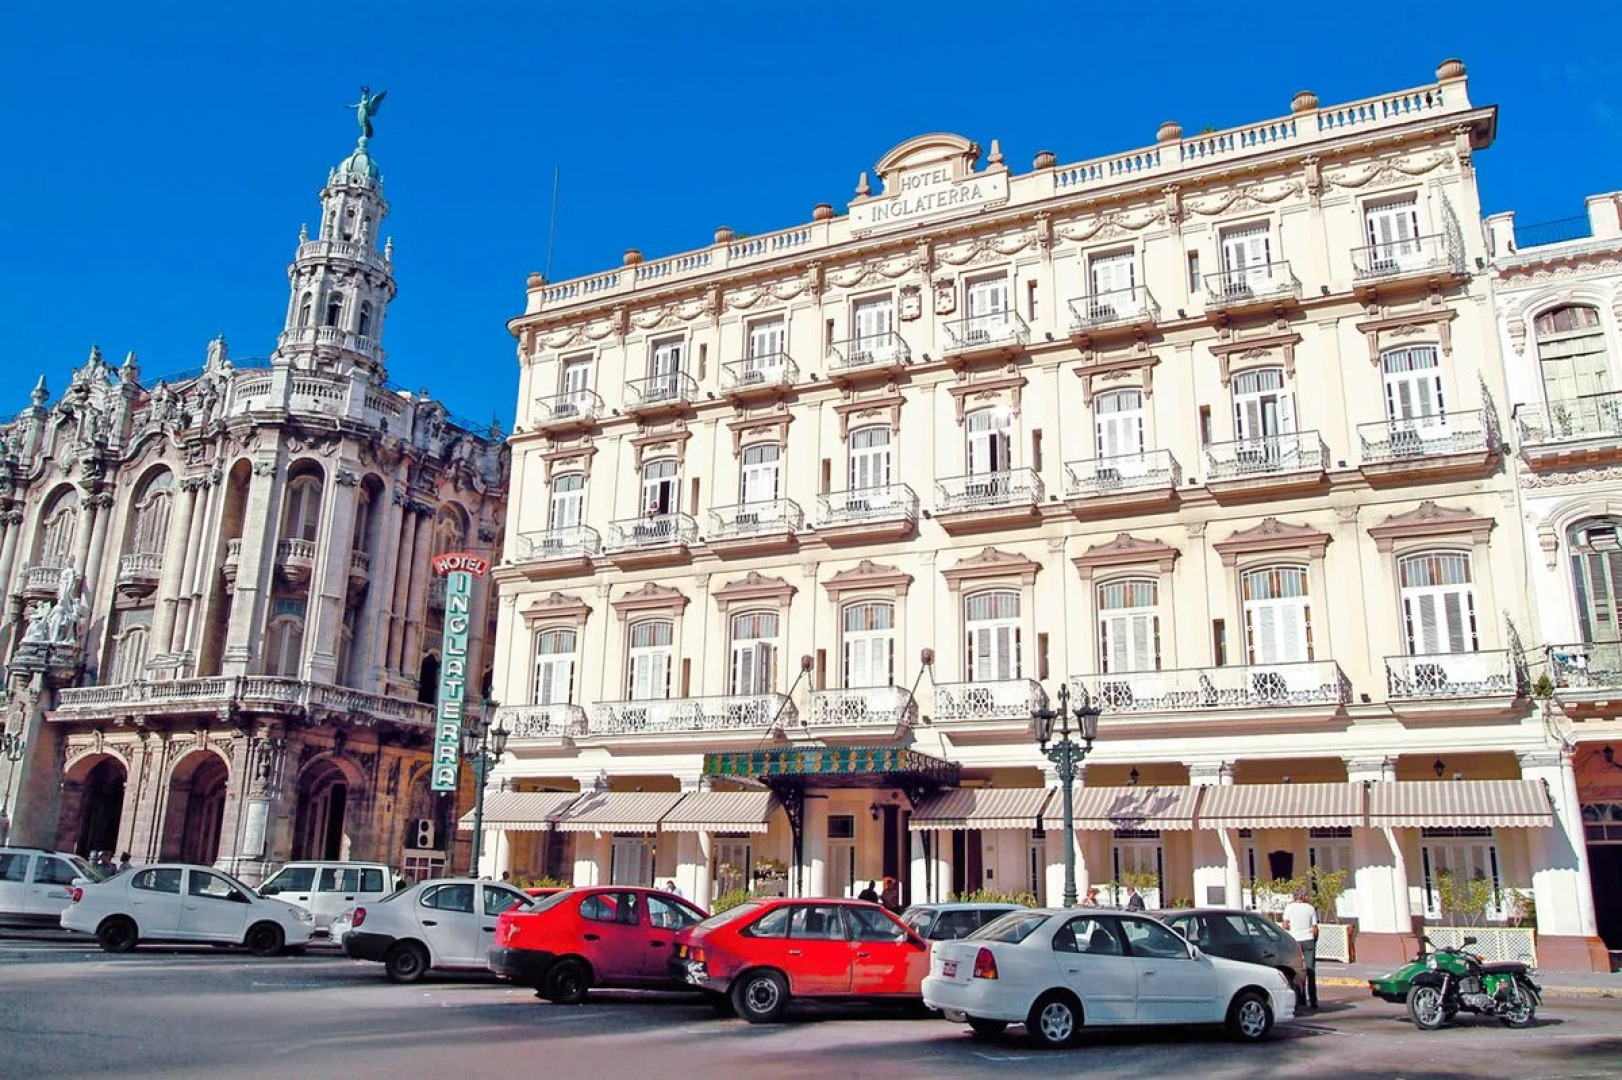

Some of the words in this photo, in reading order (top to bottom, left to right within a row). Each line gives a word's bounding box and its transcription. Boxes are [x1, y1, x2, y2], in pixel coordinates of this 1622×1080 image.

[901, 168, 951, 191] HOTEL
[871, 183, 983, 222] INGLATERRA
[437, 556, 482, 574] HOTEL
[435, 574, 468, 786] INGLATERRA
